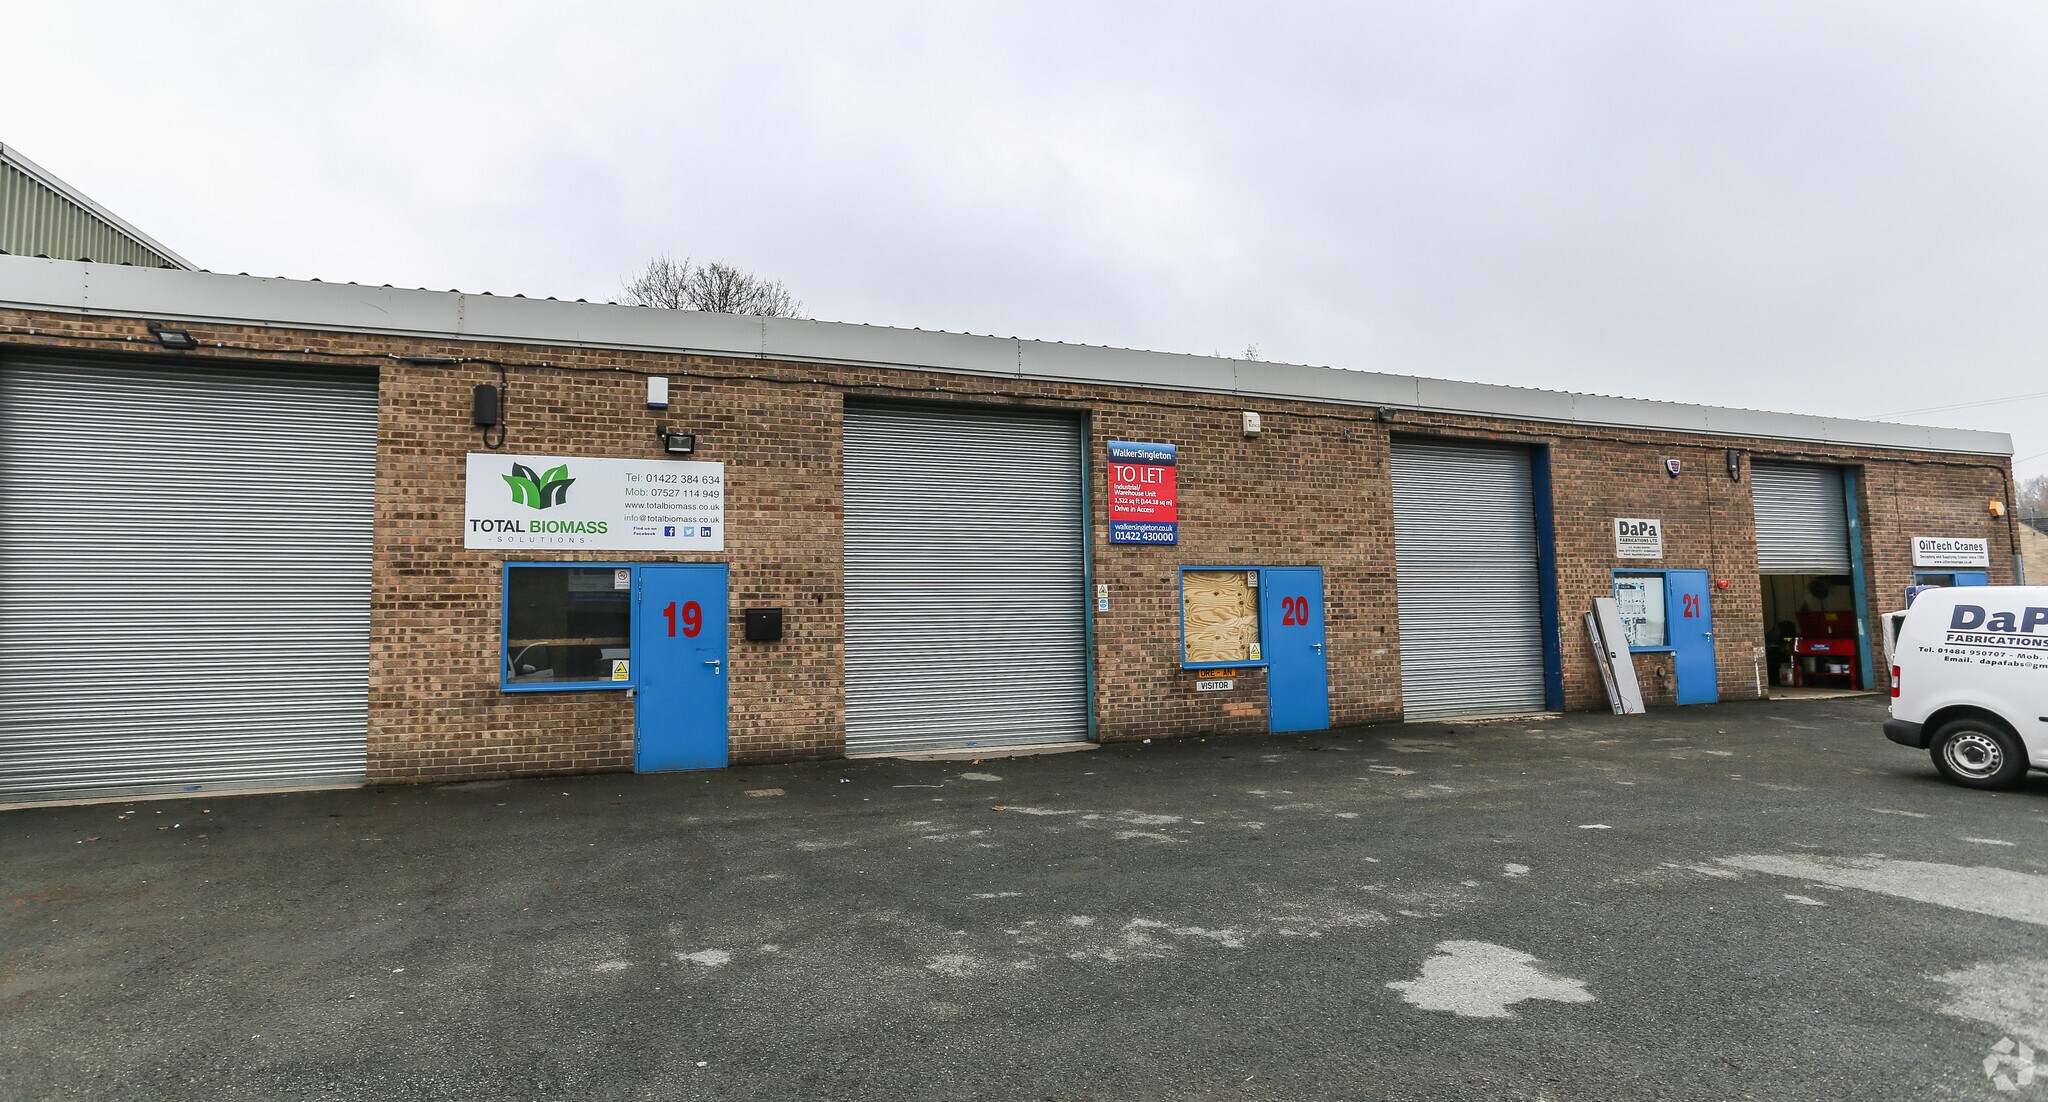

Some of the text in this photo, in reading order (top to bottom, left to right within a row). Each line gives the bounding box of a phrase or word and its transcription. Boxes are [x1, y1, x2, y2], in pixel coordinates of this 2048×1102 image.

[625, 473, 720, 484] Tel: 01422 384 634
[1114, 465, 1165, 484] TO LET
[625, 488, 648, 496] Mob:
[651, 489, 680, 497] 07527
[702, 490, 720, 498] 949
[625, 502, 720, 511] www.totalbiomass.co.uk
[624, 514, 720, 523] info@totalbiomass.co.uk
[470, 519, 608, 534] TOTAL BIOMASS
[1619, 521, 1657, 536] DaPa
[1115, 532, 1173, 541] 01422 430000
[1919, 540, 1983, 551] OilTech Cranes
[1281, 596, 1309, 626] 20
[1683, 593, 1699, 618] 21
[663, 601, 702, 638] 19
